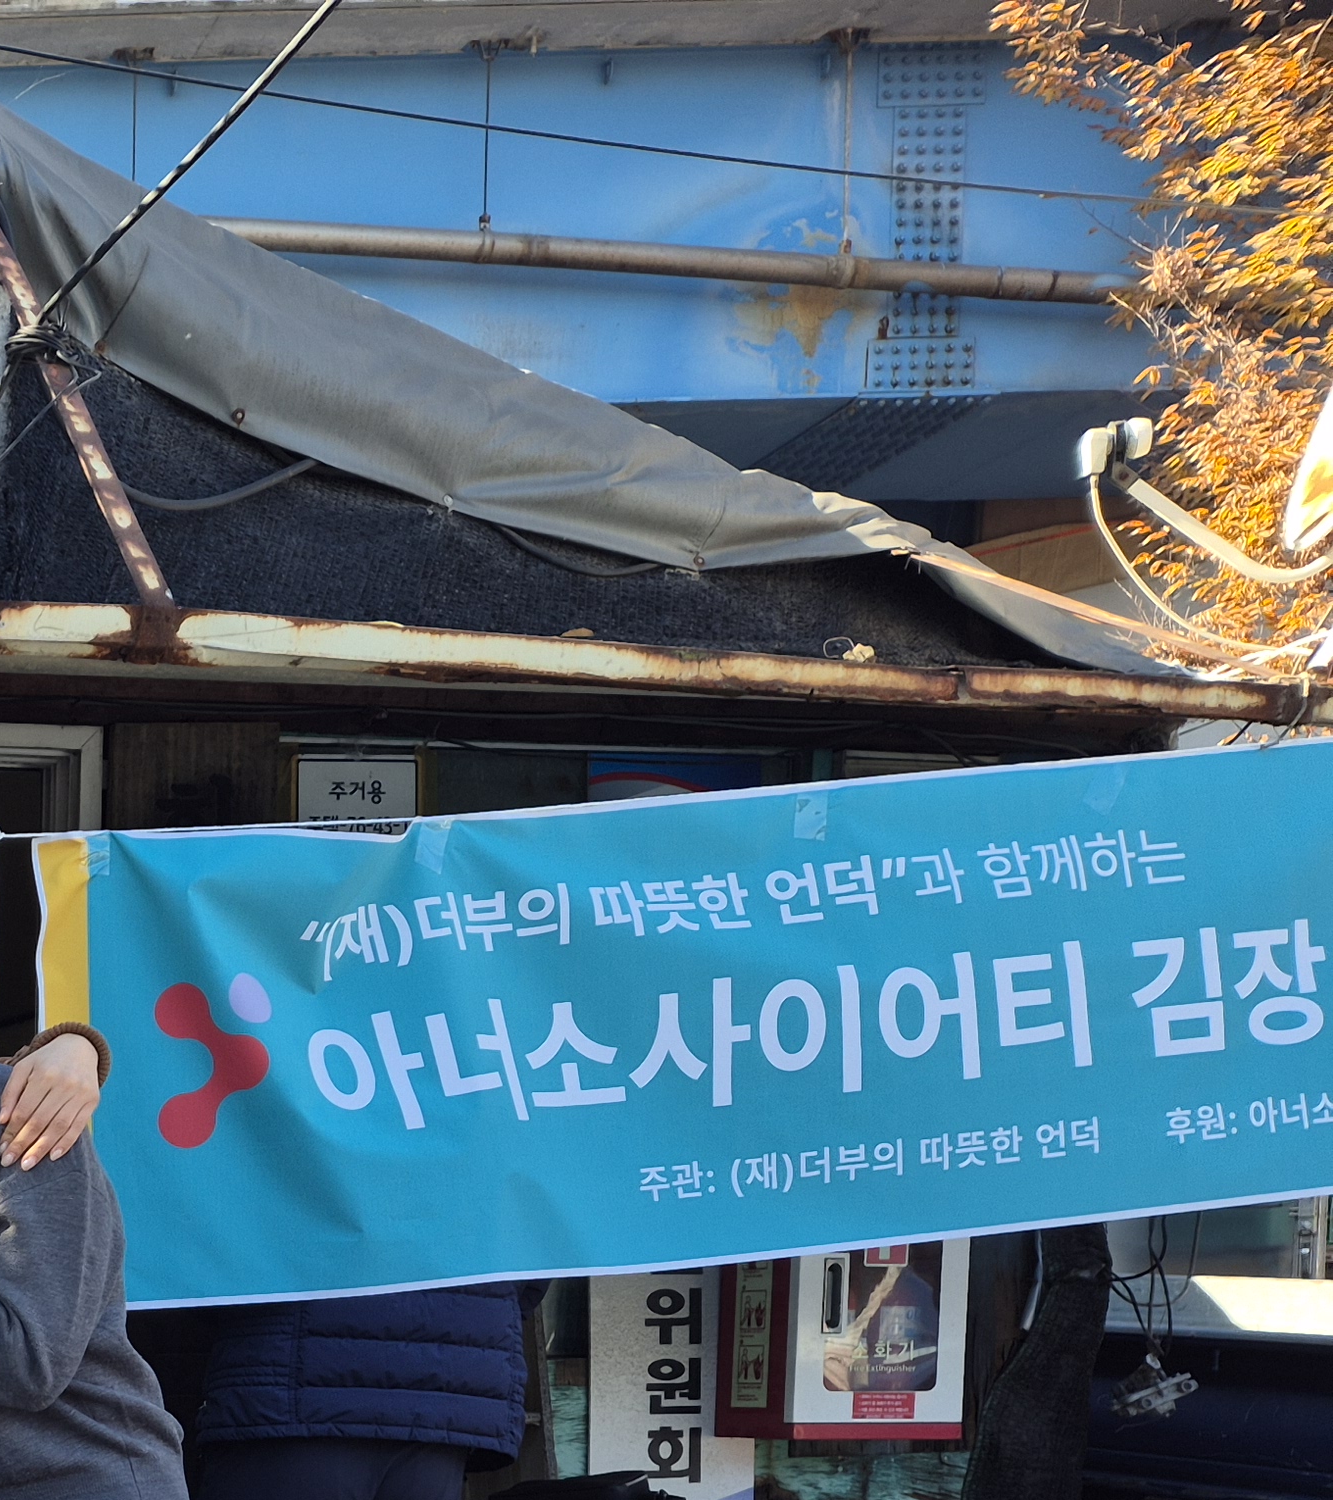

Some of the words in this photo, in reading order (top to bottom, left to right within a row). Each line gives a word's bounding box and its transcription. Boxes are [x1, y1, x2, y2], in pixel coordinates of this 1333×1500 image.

[328, 780, 386, 804] 주거용
[588, 872, 752, 937] 따뜻한
[976, 829, 1186, 899] 함께하는
[307, 939, 1094, 1131] 아너소사이어티
[1131, 918, 1327, 1058] 김장
[639, 1158, 716, 1202] 주관:
[730, 1137, 905, 1198] (재)더부의
[919, 1124, 1023, 1173] 따뜻한
[1035, 1116, 1101, 1160] 언덕
[1165, 1102, 1238, 1144] 후원:
[851, 1340, 915, 1361] 소화기
[866, 1364, 917, 1374] Extinguisher
